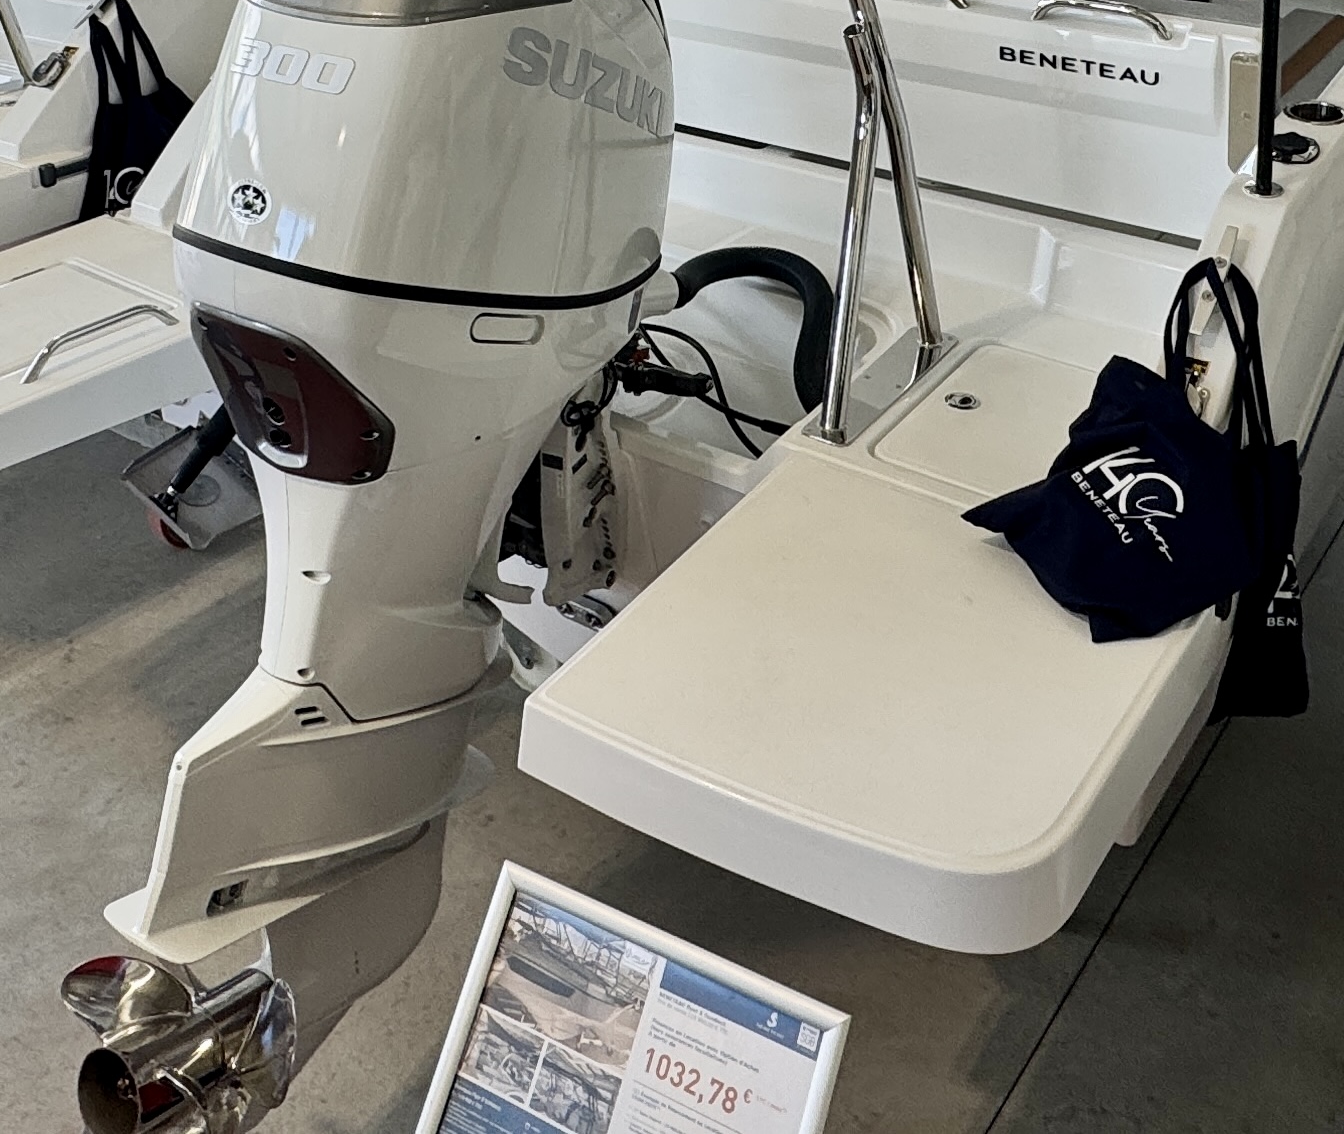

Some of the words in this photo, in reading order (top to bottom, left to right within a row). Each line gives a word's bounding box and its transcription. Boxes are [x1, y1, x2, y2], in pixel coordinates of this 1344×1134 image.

[229, 36, 356, 96] 300
[502, 26, 666, 138] SUZUKI
[998, 45, 1160, 86] BENETEAU
[1070, 470, 1134, 544] BENETEAU
[1266, 616, 1299, 627] BEN
[645, 1047, 738, 1114] 1032,78
[743, 1087, 754, 1104] €
